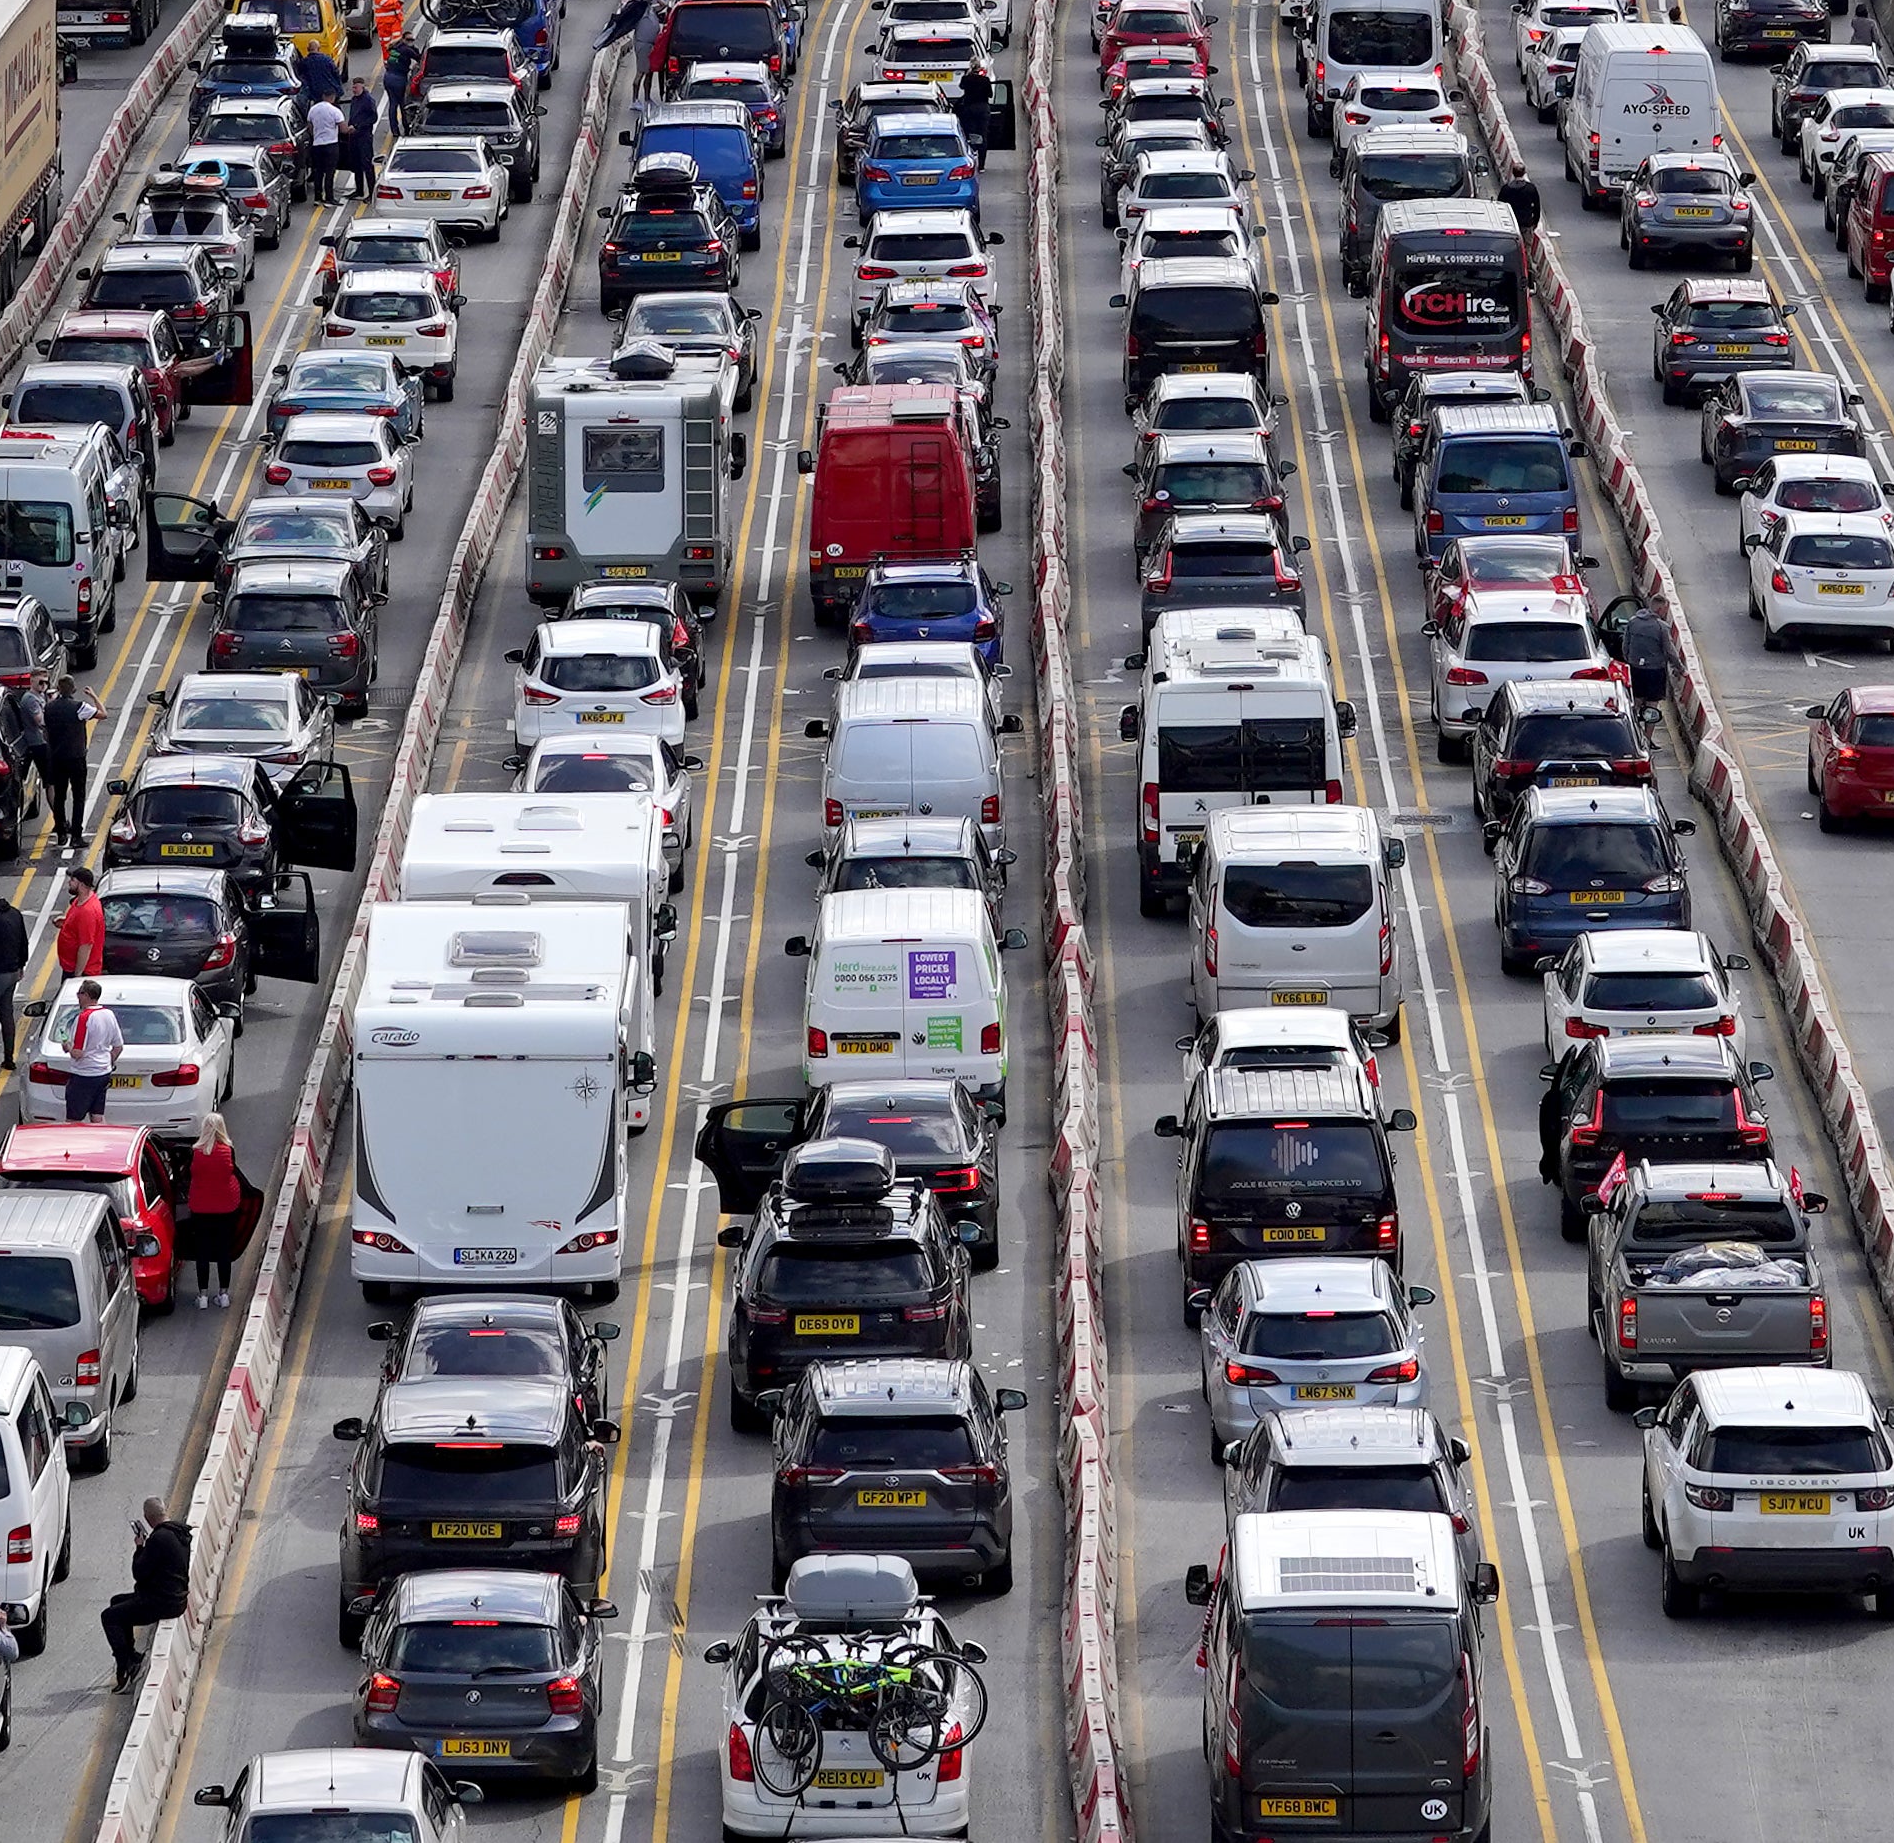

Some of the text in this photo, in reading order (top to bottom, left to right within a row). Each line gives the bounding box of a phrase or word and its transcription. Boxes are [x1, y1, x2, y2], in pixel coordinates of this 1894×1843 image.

[1622, 104, 1691, 115] AYO-SPEED
[1406, 254, 1441, 263] Hire Me
[1467, 316, 1510, 324] Vehicle Rental
[828, 546, 841, 555] UK
[9, 563, 22, 571] UK
[190, 846, 209, 856] LCA
[914, 953, 949, 963] LOWEST
[834, 962, 858, 972] Herd
[914, 964, 950, 974] PRICES
[914, 975, 951, 985] LOCALLY
[1230, 1178, 1362, 1190] JOULE ELECTRICAL SERVICES LTD
[1294, 1228, 1318, 1241] DEL
[461, 1250, 515, 1261] SL KA 226
[831, 1318, 854, 1330] OYB
[1331, 1386, 1354, 1398] SNX
[1749, 1478, 1840, 1486] DISCOVERY
[862, 1491, 920, 1505] GF20 WPT
[1768, 1498, 1824, 1510] SJ17 WCU
[437, 1523, 495, 1536] AF20 VGE
[1848, 1527, 1866, 1539] UK
[444, 1742, 509, 1755] LJ63 DNY
[818, 1771, 931, 1785] RE13 CVJ UK
[1266, 1800, 1443, 1816] YF68 BWC UK
